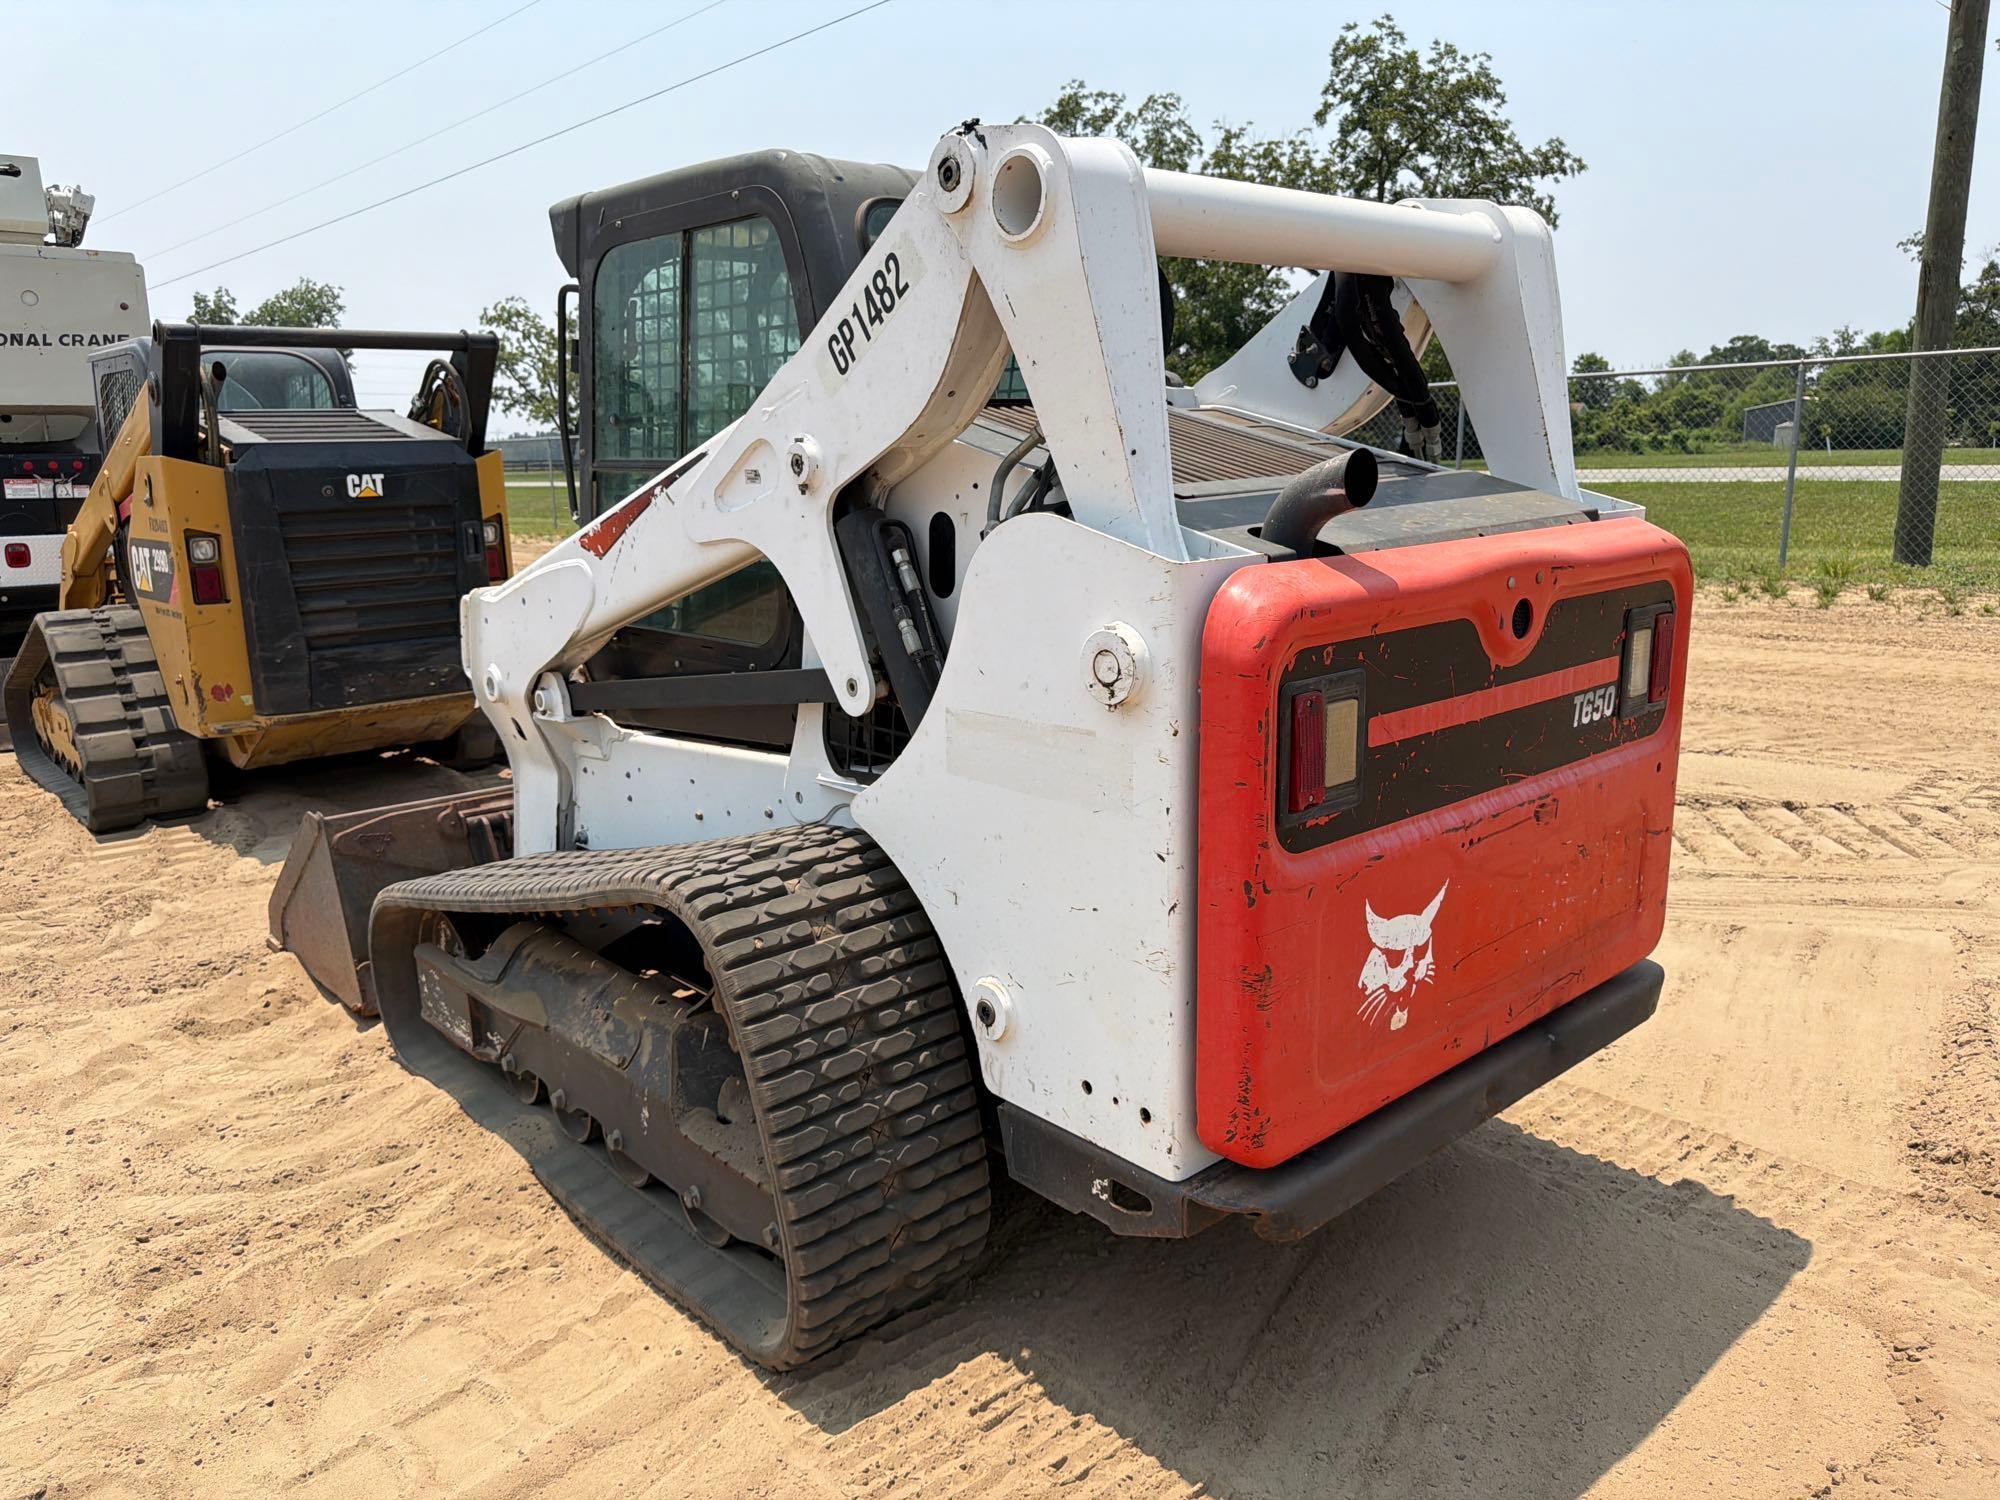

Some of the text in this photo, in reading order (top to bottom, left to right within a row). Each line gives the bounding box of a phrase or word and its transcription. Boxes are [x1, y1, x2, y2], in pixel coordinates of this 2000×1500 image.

[827, 251, 910, 376] GP1482
[58, 333, 130, 347] CRANE
[346, 473, 385, 498] CAT
[131, 545, 154, 593] CAT
[1572, 685, 1616, 729] T650
